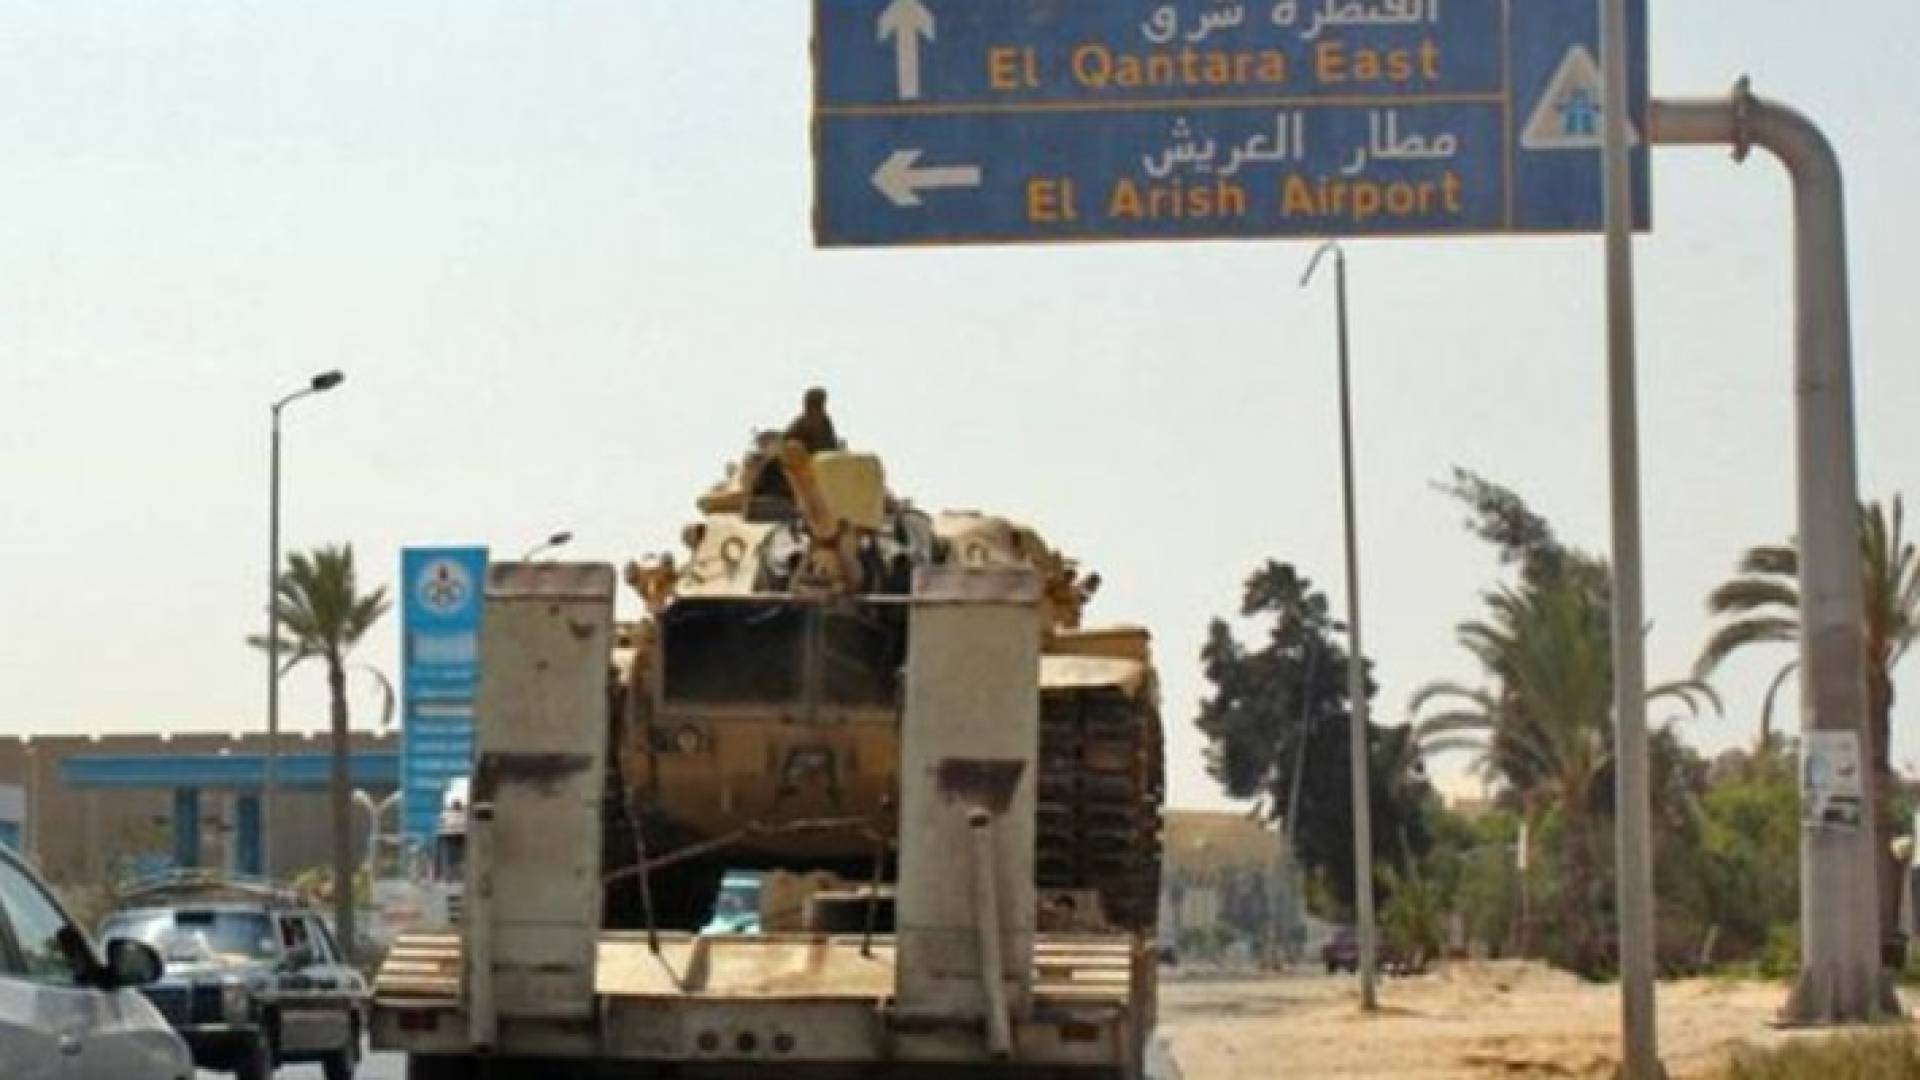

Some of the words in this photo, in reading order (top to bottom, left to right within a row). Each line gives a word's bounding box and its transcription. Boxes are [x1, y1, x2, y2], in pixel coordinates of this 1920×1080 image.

[990, 48, 1039, 88] El
[1072, 44, 1286, 87] Qantara
[1316, 43, 1440, 84] East
[1142, 111, 1303, 178] العريش
[1341, 110, 1457, 176] مطار
[1027, 177, 1078, 220] El
[1109, 176, 1246, 217] Arish
[1281, 171, 1462, 223] Airport
